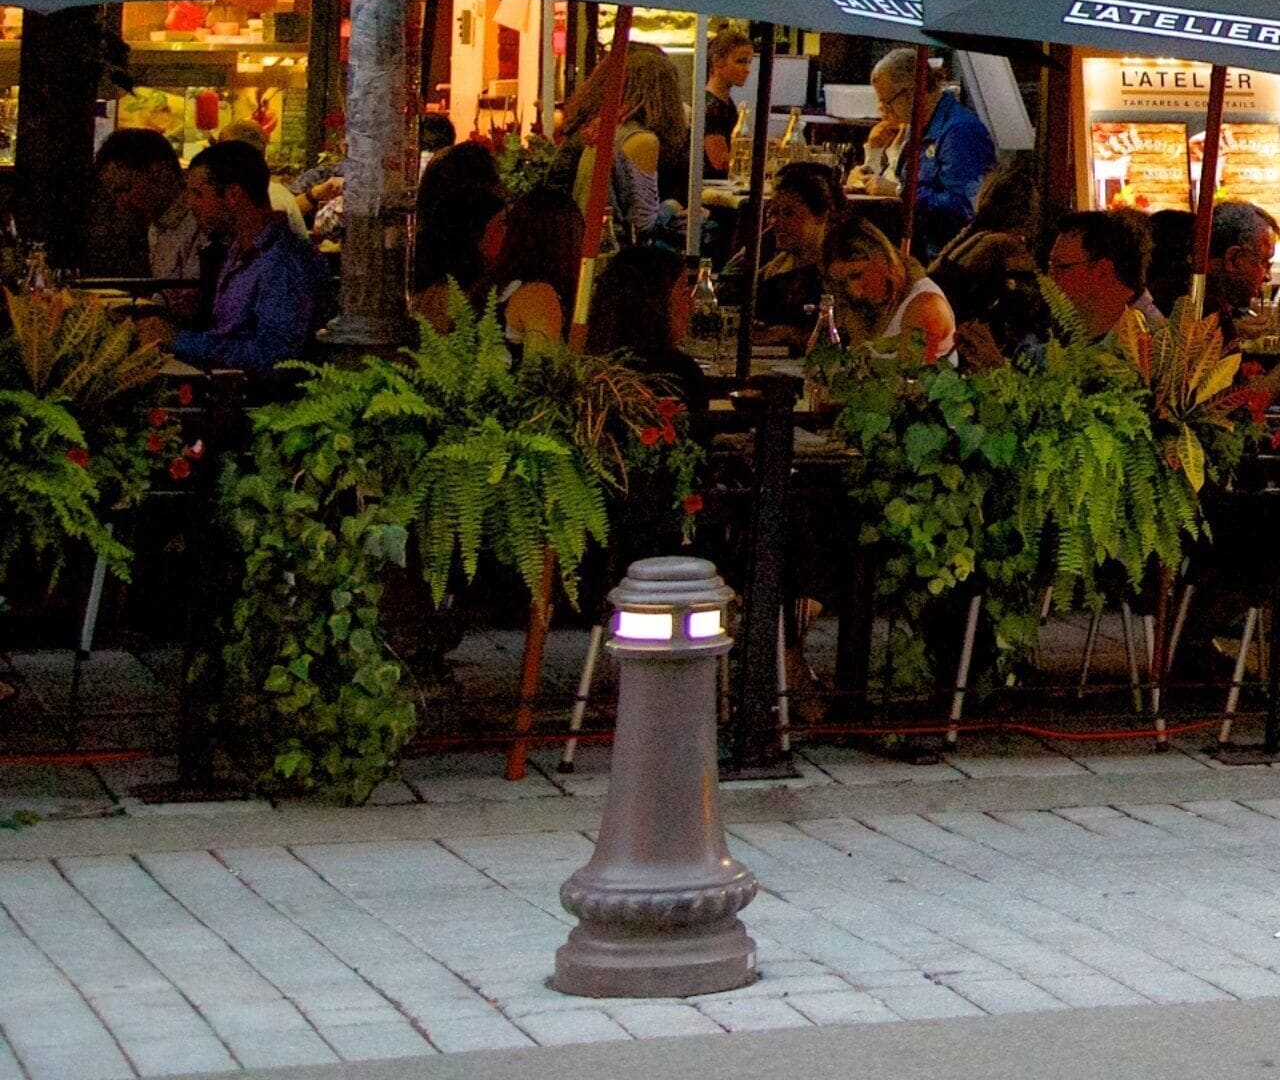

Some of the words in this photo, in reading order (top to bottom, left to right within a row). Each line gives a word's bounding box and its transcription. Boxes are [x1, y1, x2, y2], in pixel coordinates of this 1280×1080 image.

[1121, 70, 1252, 89] L'ATELER
[1123, 99, 1180, 108] TARTARES
[1194, 101, 1257, 109] COTAILS
